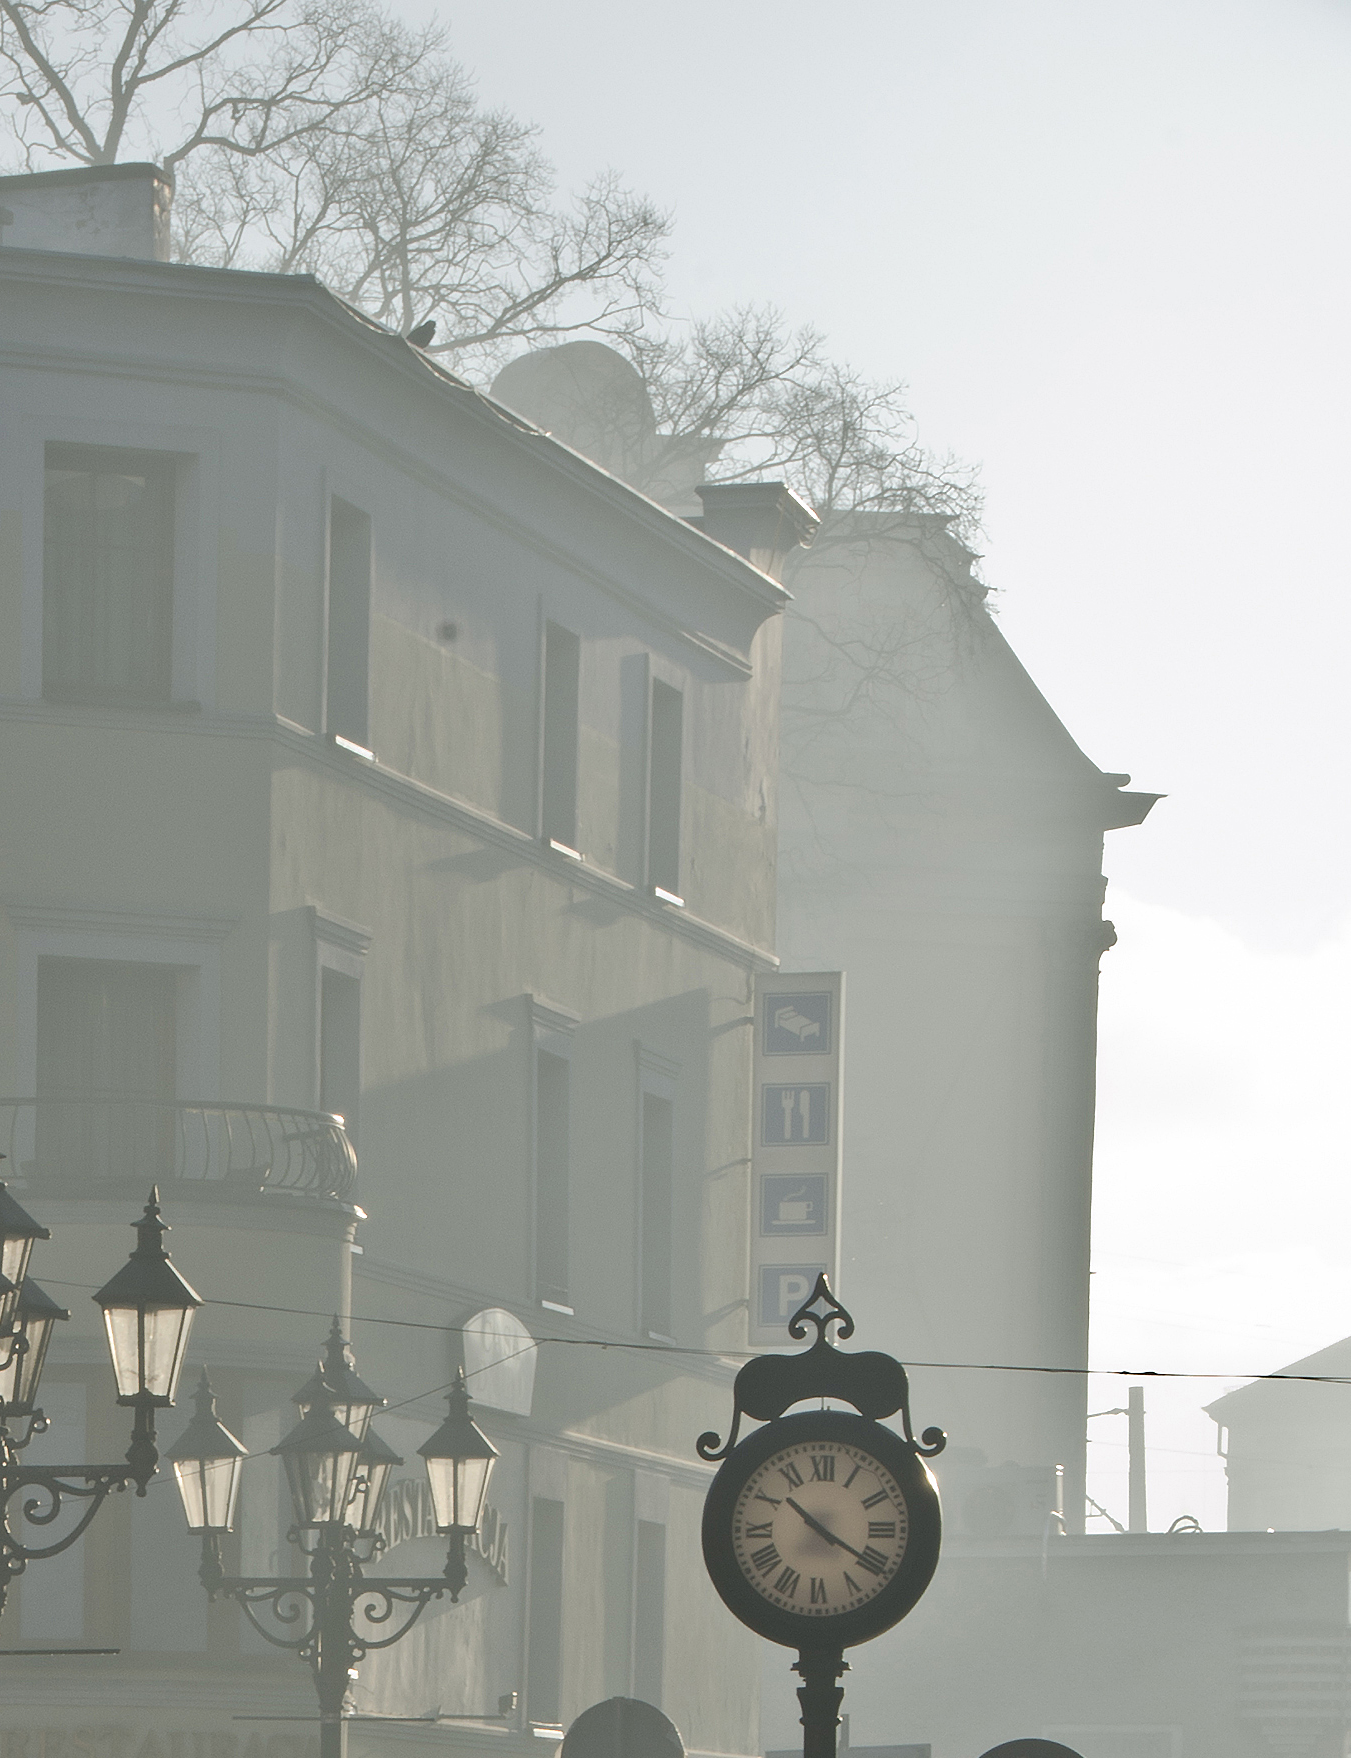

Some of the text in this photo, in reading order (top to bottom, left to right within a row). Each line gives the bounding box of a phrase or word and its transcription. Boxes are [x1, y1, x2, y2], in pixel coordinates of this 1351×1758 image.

[778, 1273, 810, 1317] P
[778, 1462, 805, 1492] XI
[809, 1454, 836, 1482] XII
[842, 1464, 863, 1488] I
[755, 1487, 781, 1511] X
[860, 1490, 889, 1511] II
[746, 1521, 773, 1539] IX
[868, 1521, 896, 1539] III
[750, 1542, 783, 1578] VIII
[773, 1567, 802, 1599] VII
[810, 1577, 828, 1604] VI
[843, 1570, 862, 1597] V
